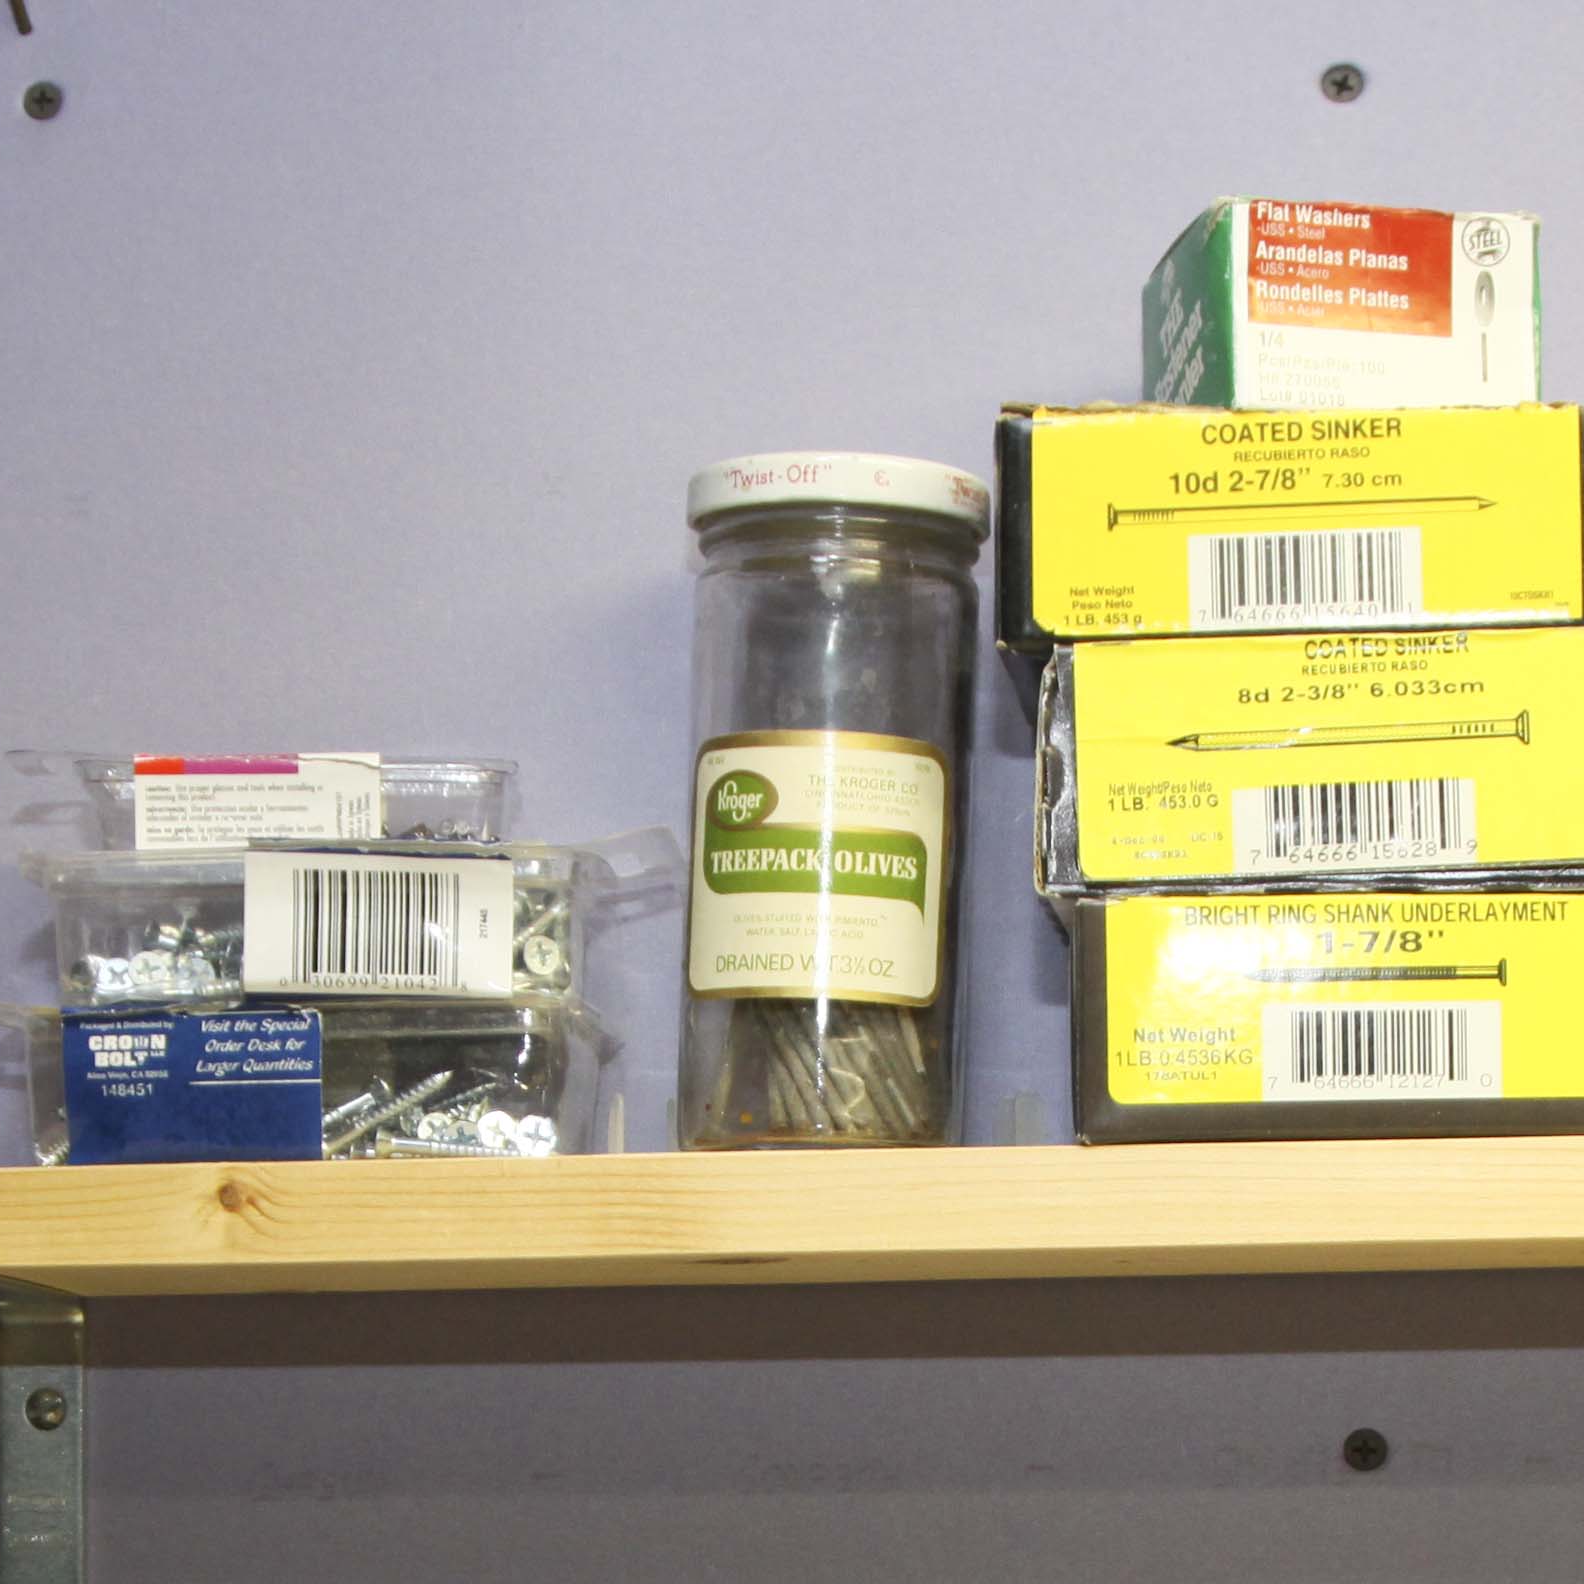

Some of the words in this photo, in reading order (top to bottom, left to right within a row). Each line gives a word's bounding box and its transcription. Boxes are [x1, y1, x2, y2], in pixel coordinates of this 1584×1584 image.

[1257, 201, 1289, 221] Flat
[1296, 204, 1370, 229] Washers
[1298, 226, 1326, 239] Steel
[1468, 228, 1503, 252] STEEL
[1256, 240, 1343, 266] Arandelas
[1349, 249, 1408, 271] Planas
[1255, 280, 1343, 305] Rondelles
[1349, 287, 1409, 310] Plattes
[1200, 421, 1303, 445] COATED
[1310, 417, 1402, 440] SINKER
[1233, 447, 1326, 463] RECUBIERTO
[1330, 446, 1371, 459] RASO
[1169, 470, 1219, 495] 10d
[1321, 472, 1366, 489] 7.30
[1371, 474, 1403, 487] cm
[1070, 585, 1095, 597] Net
[1098, 584, 1135, 598] Weight
[1071, 598, 1099, 612] Peso
[1105, 598, 1133, 610] Neto
[1075, 613, 1101, 626] LB.
[1105, 613, 1130, 626] 453
[1304, 637, 1388, 660] COATED
[1394, 634, 1470, 657] SINKER
[1300, 662, 1387, 676] RECUBIERTO
[1390, 660, 1429, 672] RASO
[1237, 687, 1270, 705] 8d
[1369, 678, 1485, 698] 6.033cm
[839, 777, 896, 792] KROGER
[1108, 783, 1130, 796] Net
[1188, 780, 1213, 794] Neto
[717, 780, 763, 822] Kroger
[1158, 794, 1202, 809] 453.0
[1206, 794, 1219, 808] G
[710, 848, 823, 874] TREEPACK
[835, 849, 917, 880] OLIVES
[1184, 905, 1261, 925] BRIGHT
[1266, 904, 1317, 924] RING
[1323, 903, 1394, 923] SHANK
[1400, 901, 1569, 923] UNDERLAYMENT
[715, 954, 794, 973] DRAINED
[200, 1019, 230, 1032] Visit
[234, 1020, 257, 1032] the
[260, 1018, 311, 1033] Special
[88, 1034, 166, 1050] CROWN
[205, 1039, 244, 1053] Order
[248, 1038, 282, 1052] Desk
[285, 1038, 305, 1051] for
[1132, 1027, 1166, 1044] Net
[1171, 1027, 1236, 1046] Weight
[94, 1051, 147, 1068] BOLT
[196, 1059, 239, 1077] Larger
[243, 1058, 313, 1073] Quantities
[101, 1083, 154, 1097] 148451
